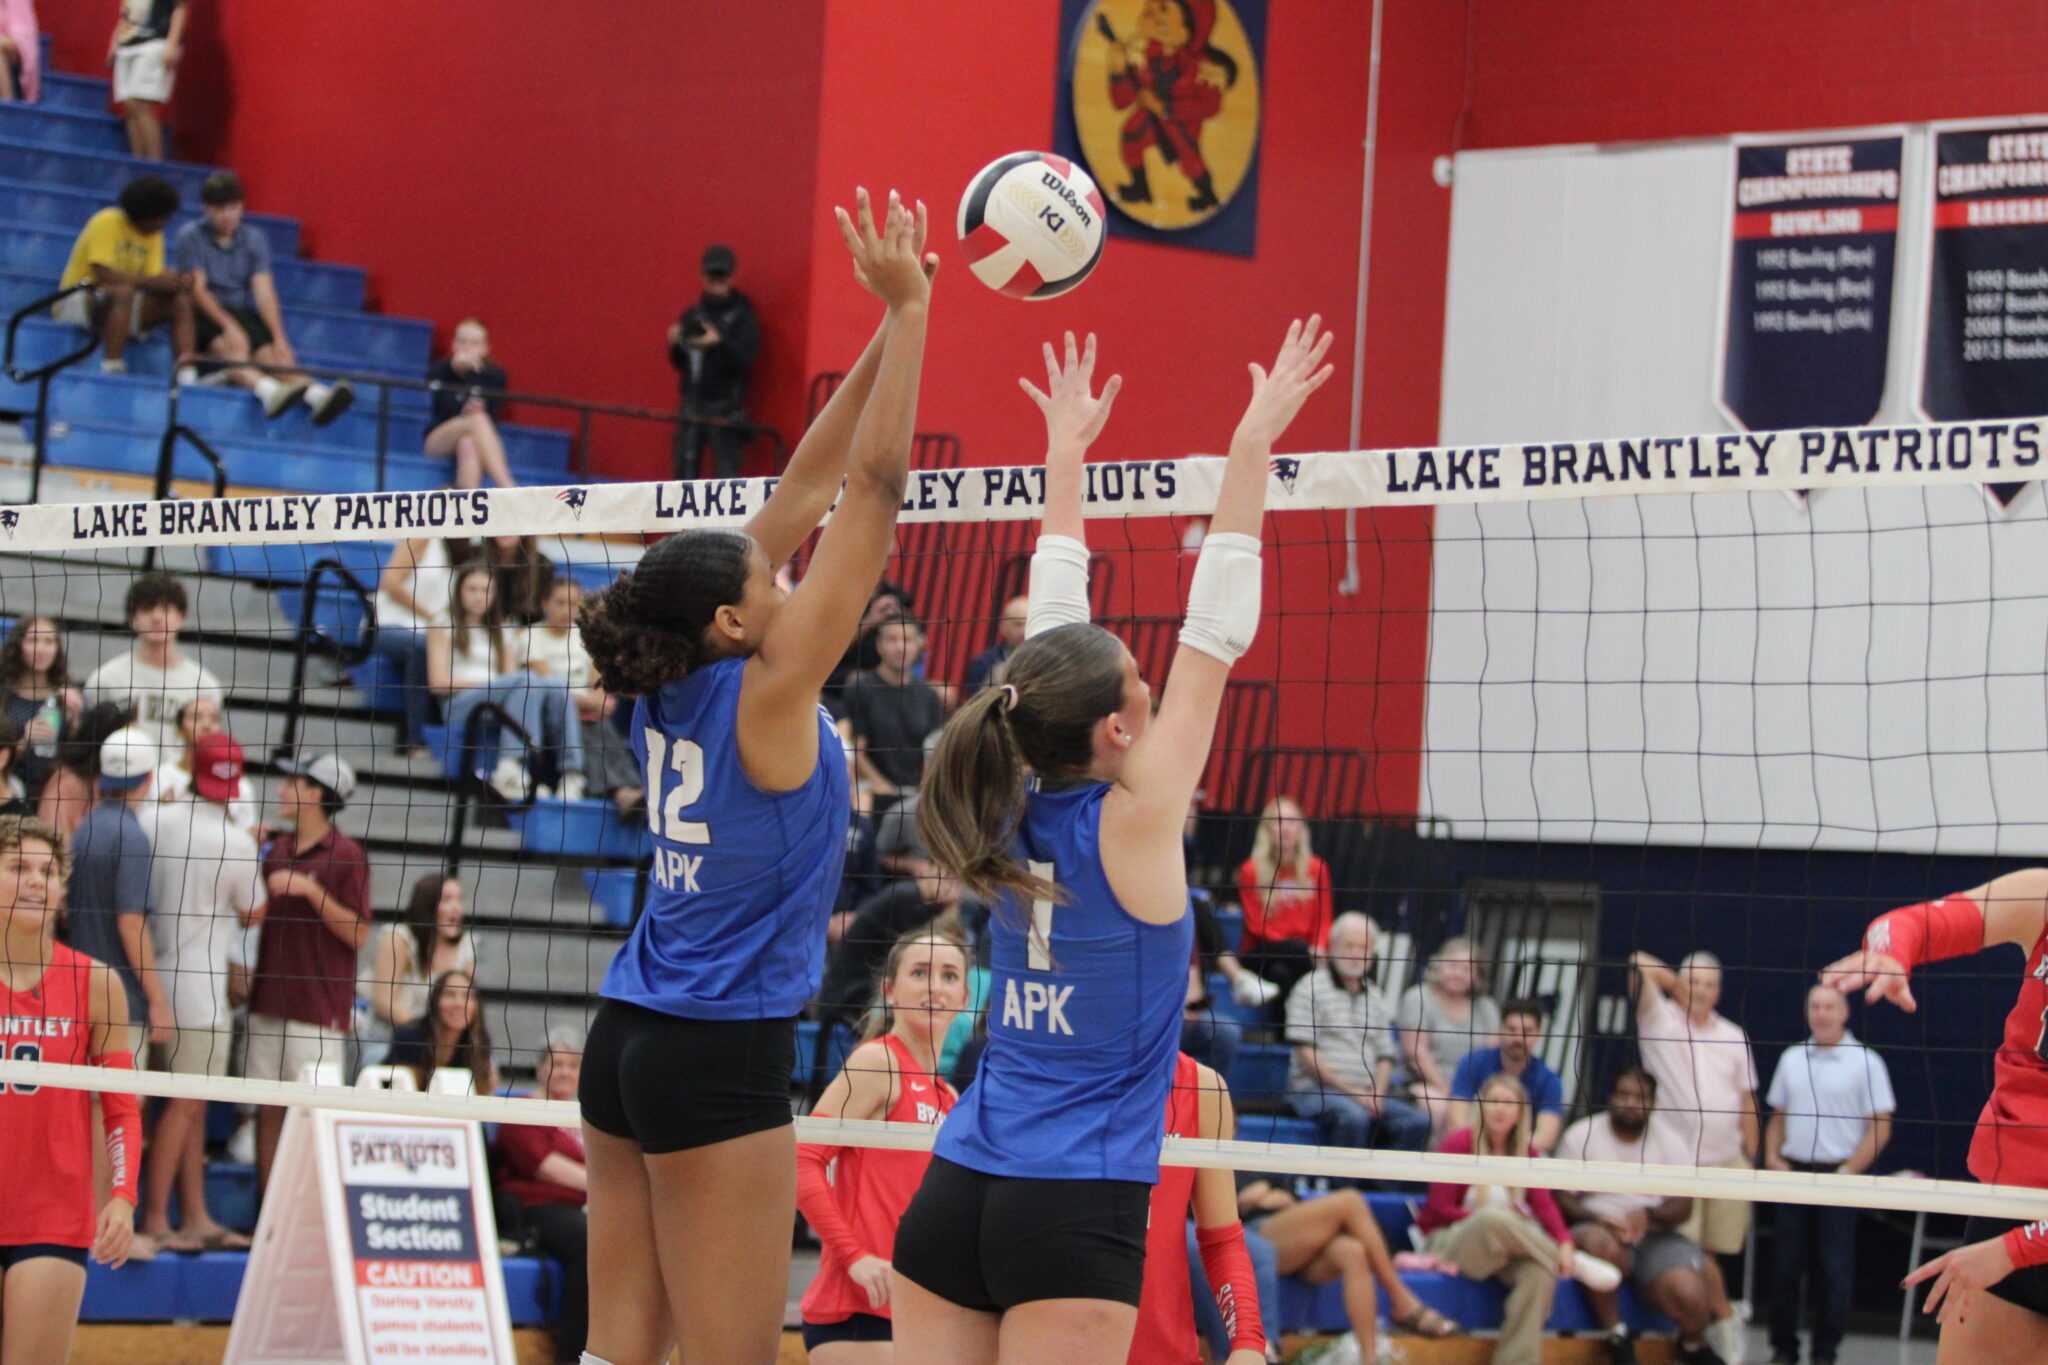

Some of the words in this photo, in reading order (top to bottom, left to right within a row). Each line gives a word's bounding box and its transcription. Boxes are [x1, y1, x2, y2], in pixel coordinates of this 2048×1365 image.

[1787, 145, 1853, 175] STATE
[1041, 171, 1091, 229] Wilson
[1738, 169, 1897, 207] CHAMPIONSHIPS
[1770, 208, 1862, 237] BOWLING
[1387, 447, 1500, 493] LAKE
[1522, 434, 1776, 486] BRANTLEY
[1799, 423, 2041, 475] PATRIOTS
[655, 480, 748, 518] LAKE
[983, 461, 1176, 506] PATIOTS
[73, 503, 147, 539] LAKE
[159, 496, 321, 535] BRANTLEY
[334, 490, 489, 530] PATRIOTS
[644, 726, 711, 845] 12
[655, 845, 704, 893] APK
[1027, 859, 1055, 972] 1
[1002, 978, 1075, 1036] APK
[351, 1141, 456, 1169] PATRIOTS
[360, 1192, 461, 1223] Student
[366, 1221, 463, 1251] Section
[366, 1262, 472, 1286] CAUTION
[371, 1294, 421, 1311] During
